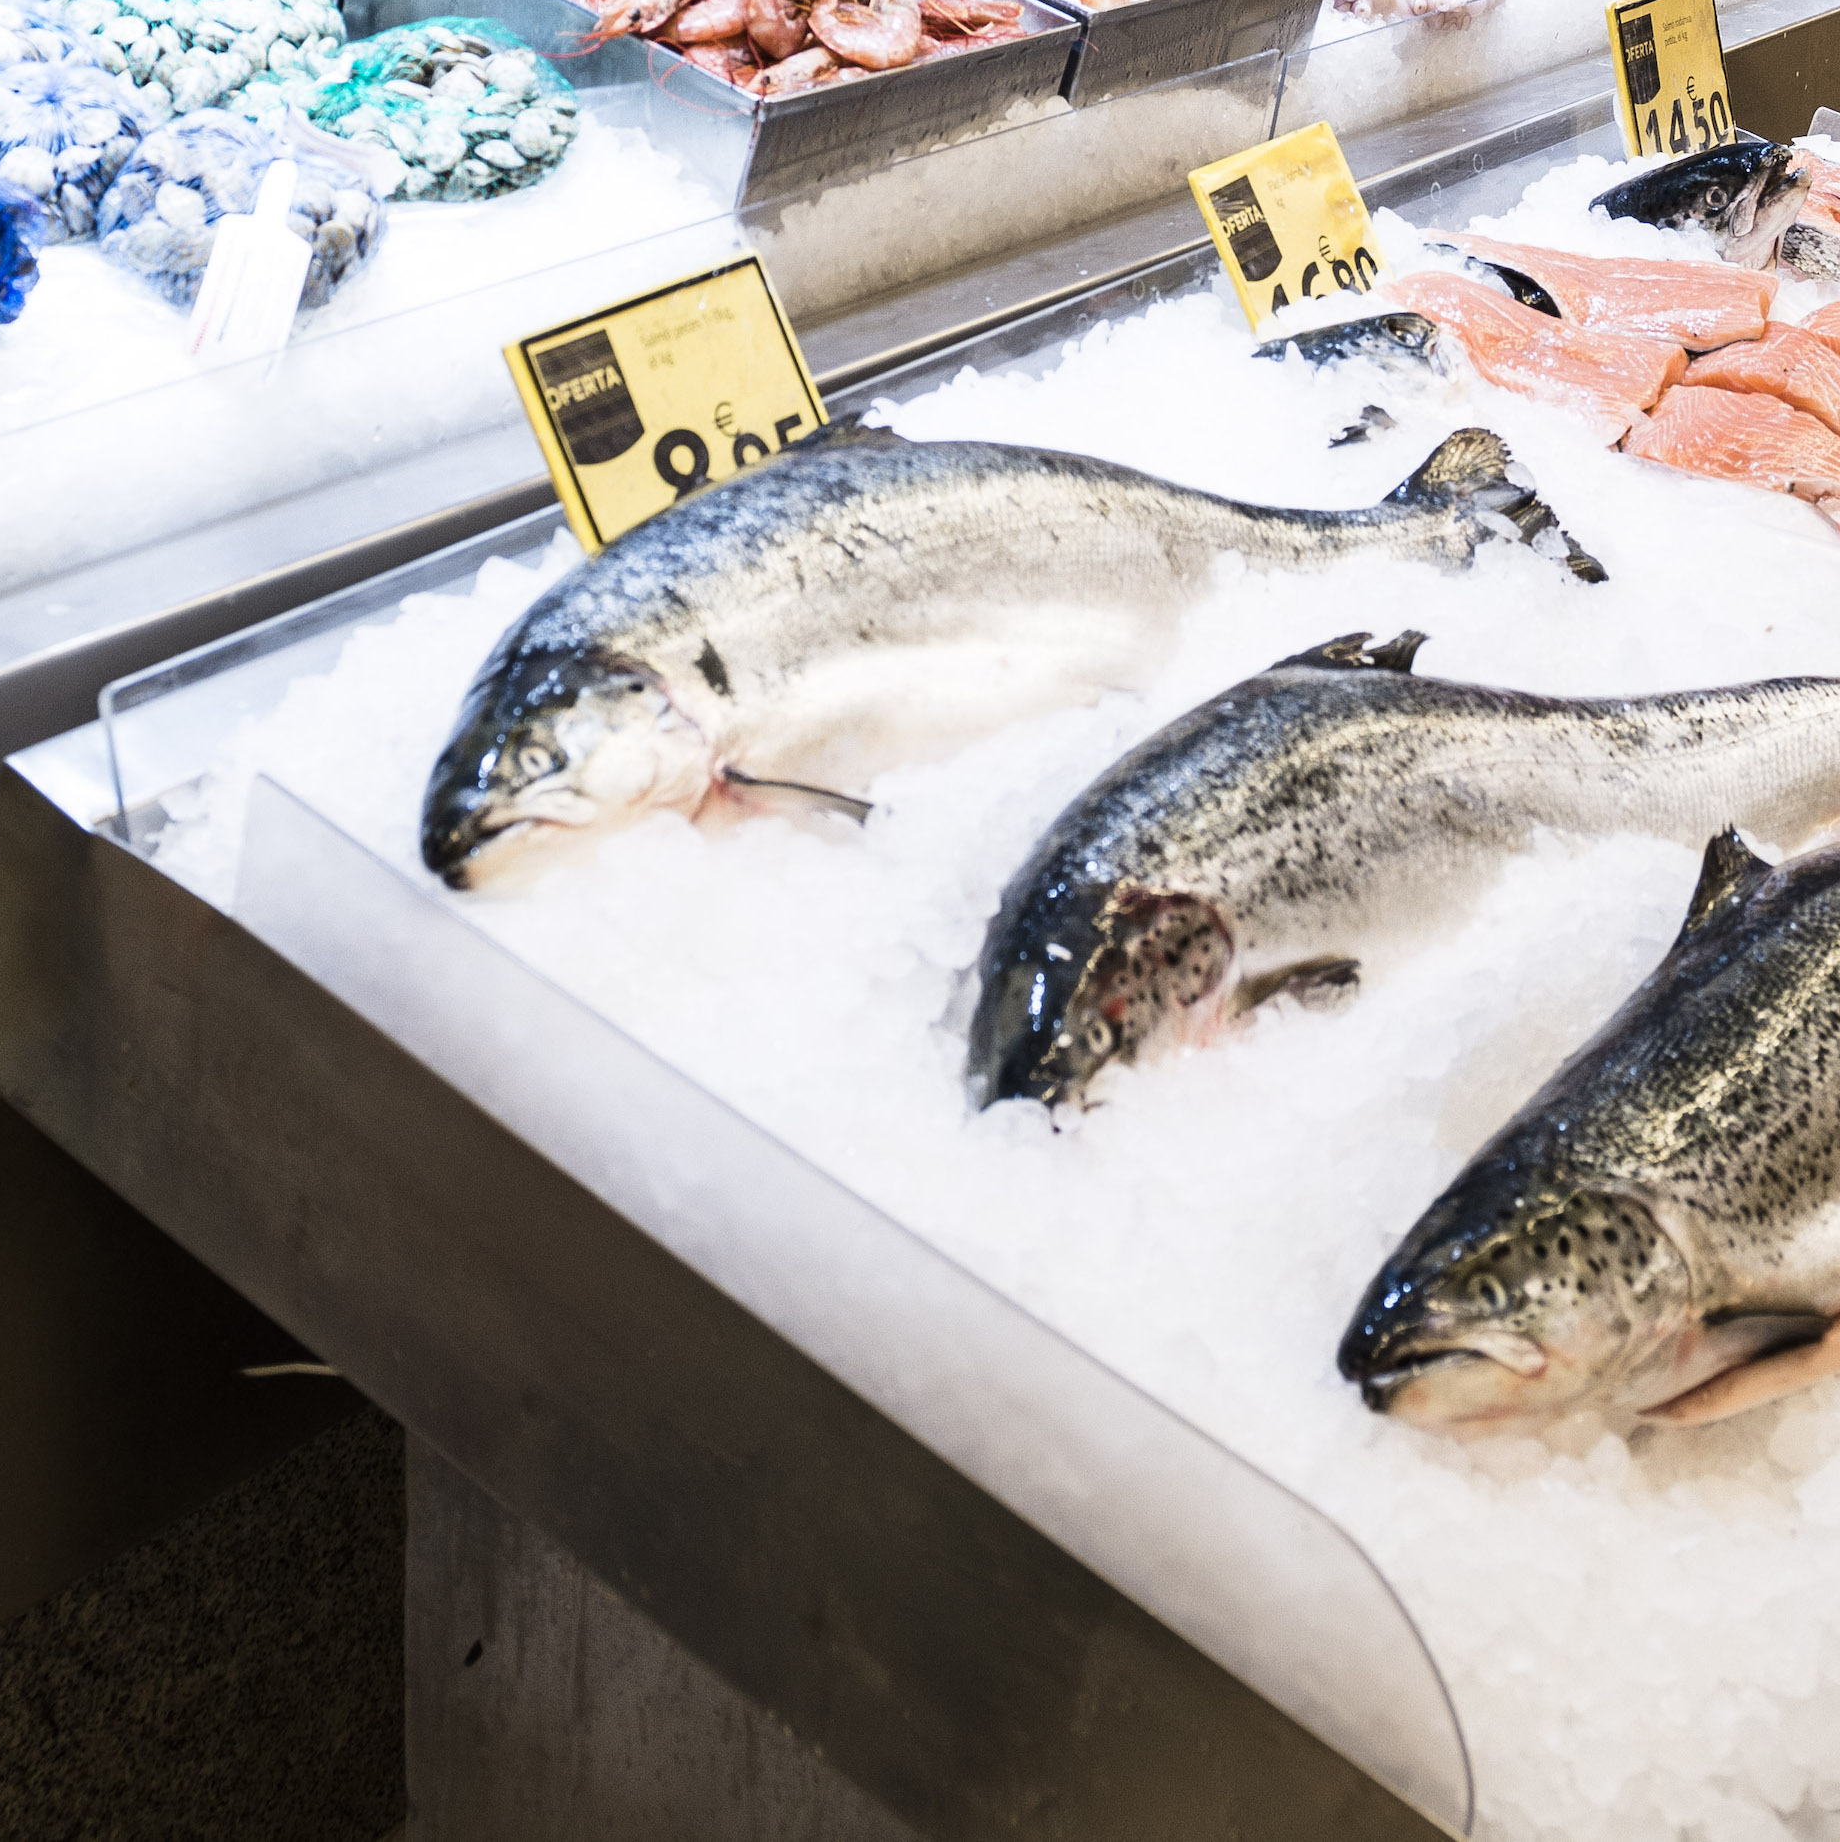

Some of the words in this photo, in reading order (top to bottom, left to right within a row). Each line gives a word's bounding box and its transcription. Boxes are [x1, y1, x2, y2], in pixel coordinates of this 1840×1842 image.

[1646, 91, 1729, 156] 1450
[1220, 204, 1266, 239] OFERTA
[546, 365, 622, 412] OFERTA
[714, 401, 740, 437] €
